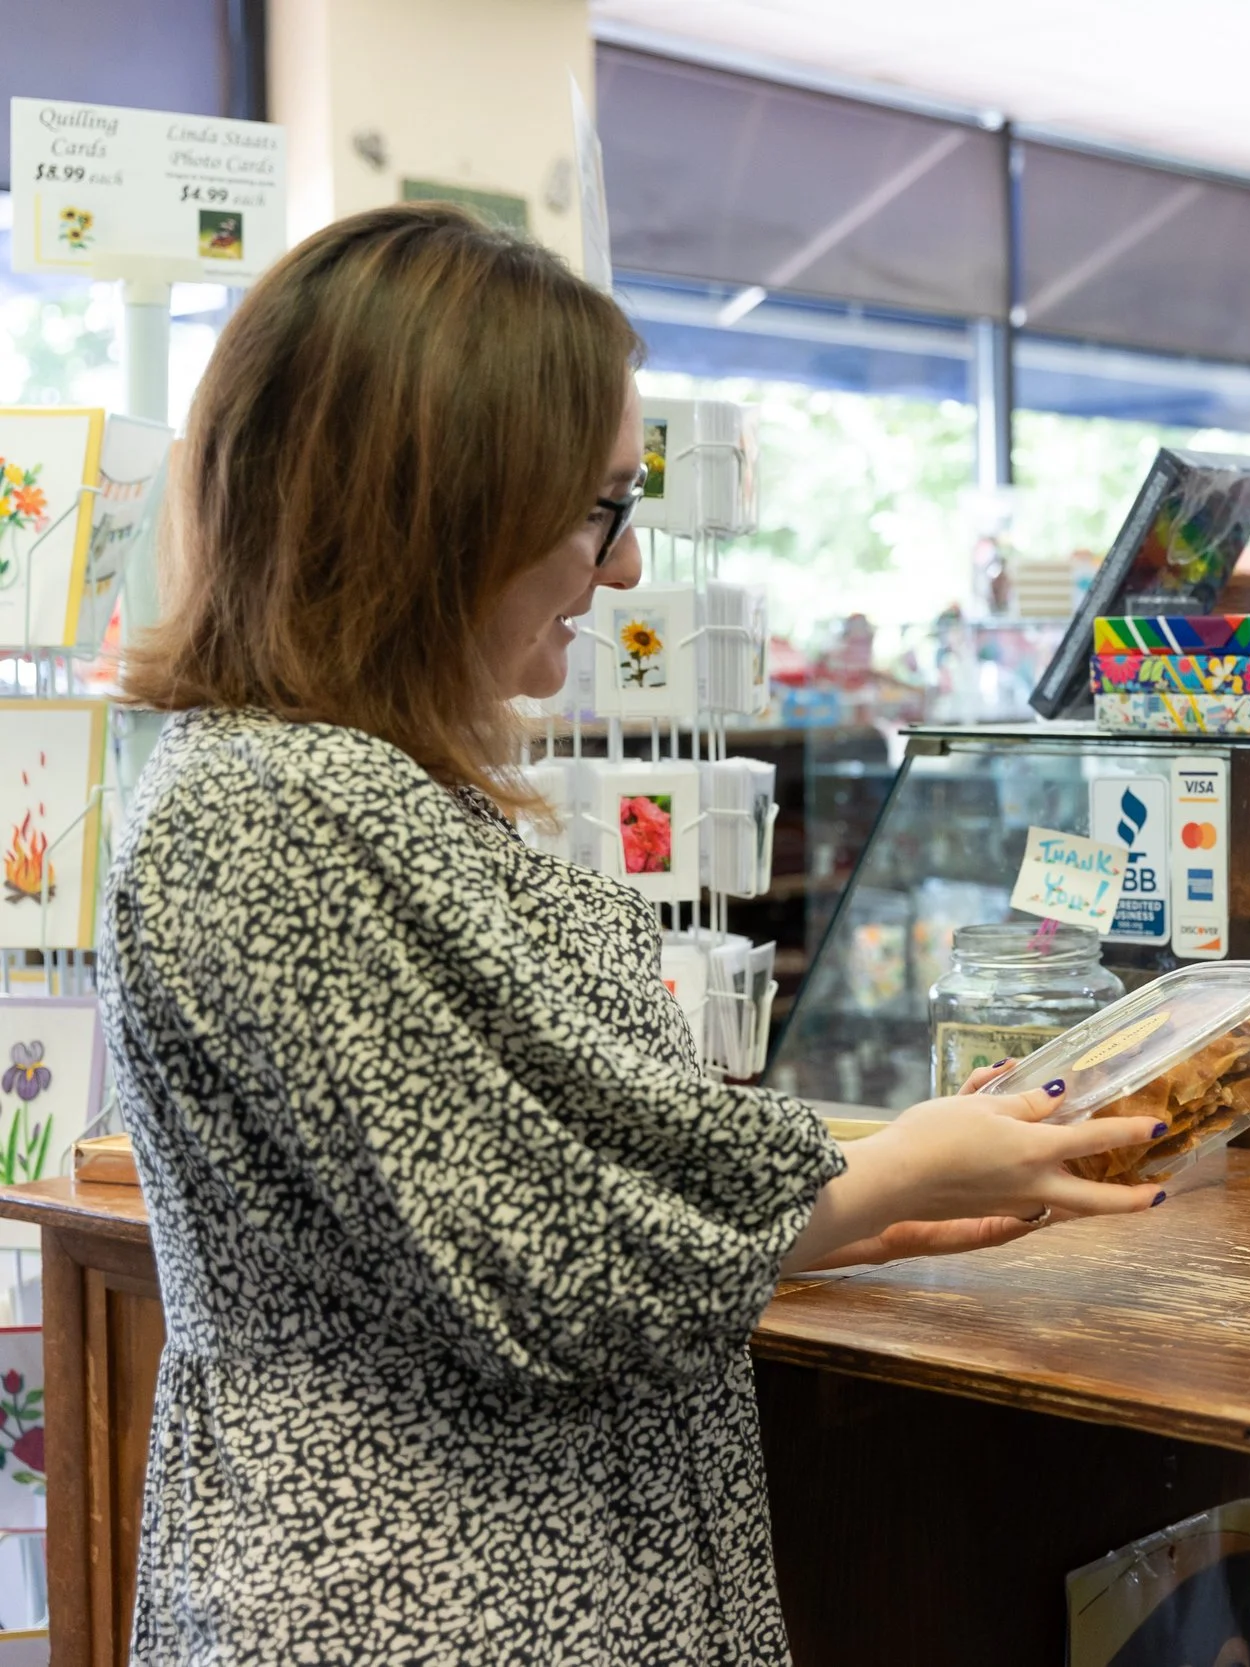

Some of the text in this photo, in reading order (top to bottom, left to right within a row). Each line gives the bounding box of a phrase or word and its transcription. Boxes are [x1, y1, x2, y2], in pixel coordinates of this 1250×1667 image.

[40, 107, 120, 137] Quilling
[166, 124, 218, 145] Linda
[51, 137, 108, 158] Cards
[169, 149, 275, 174] Photo Cards
[1184, 780, 1214, 793] VISA
[1039, 840, 1113, 876] THANK
[1122, 867, 1157, 892] BB
[1114, 910, 1155, 922] USINESS
[1118, 900, 1162, 912] REDITED
[1181, 926, 1219, 935] DISCOVER
